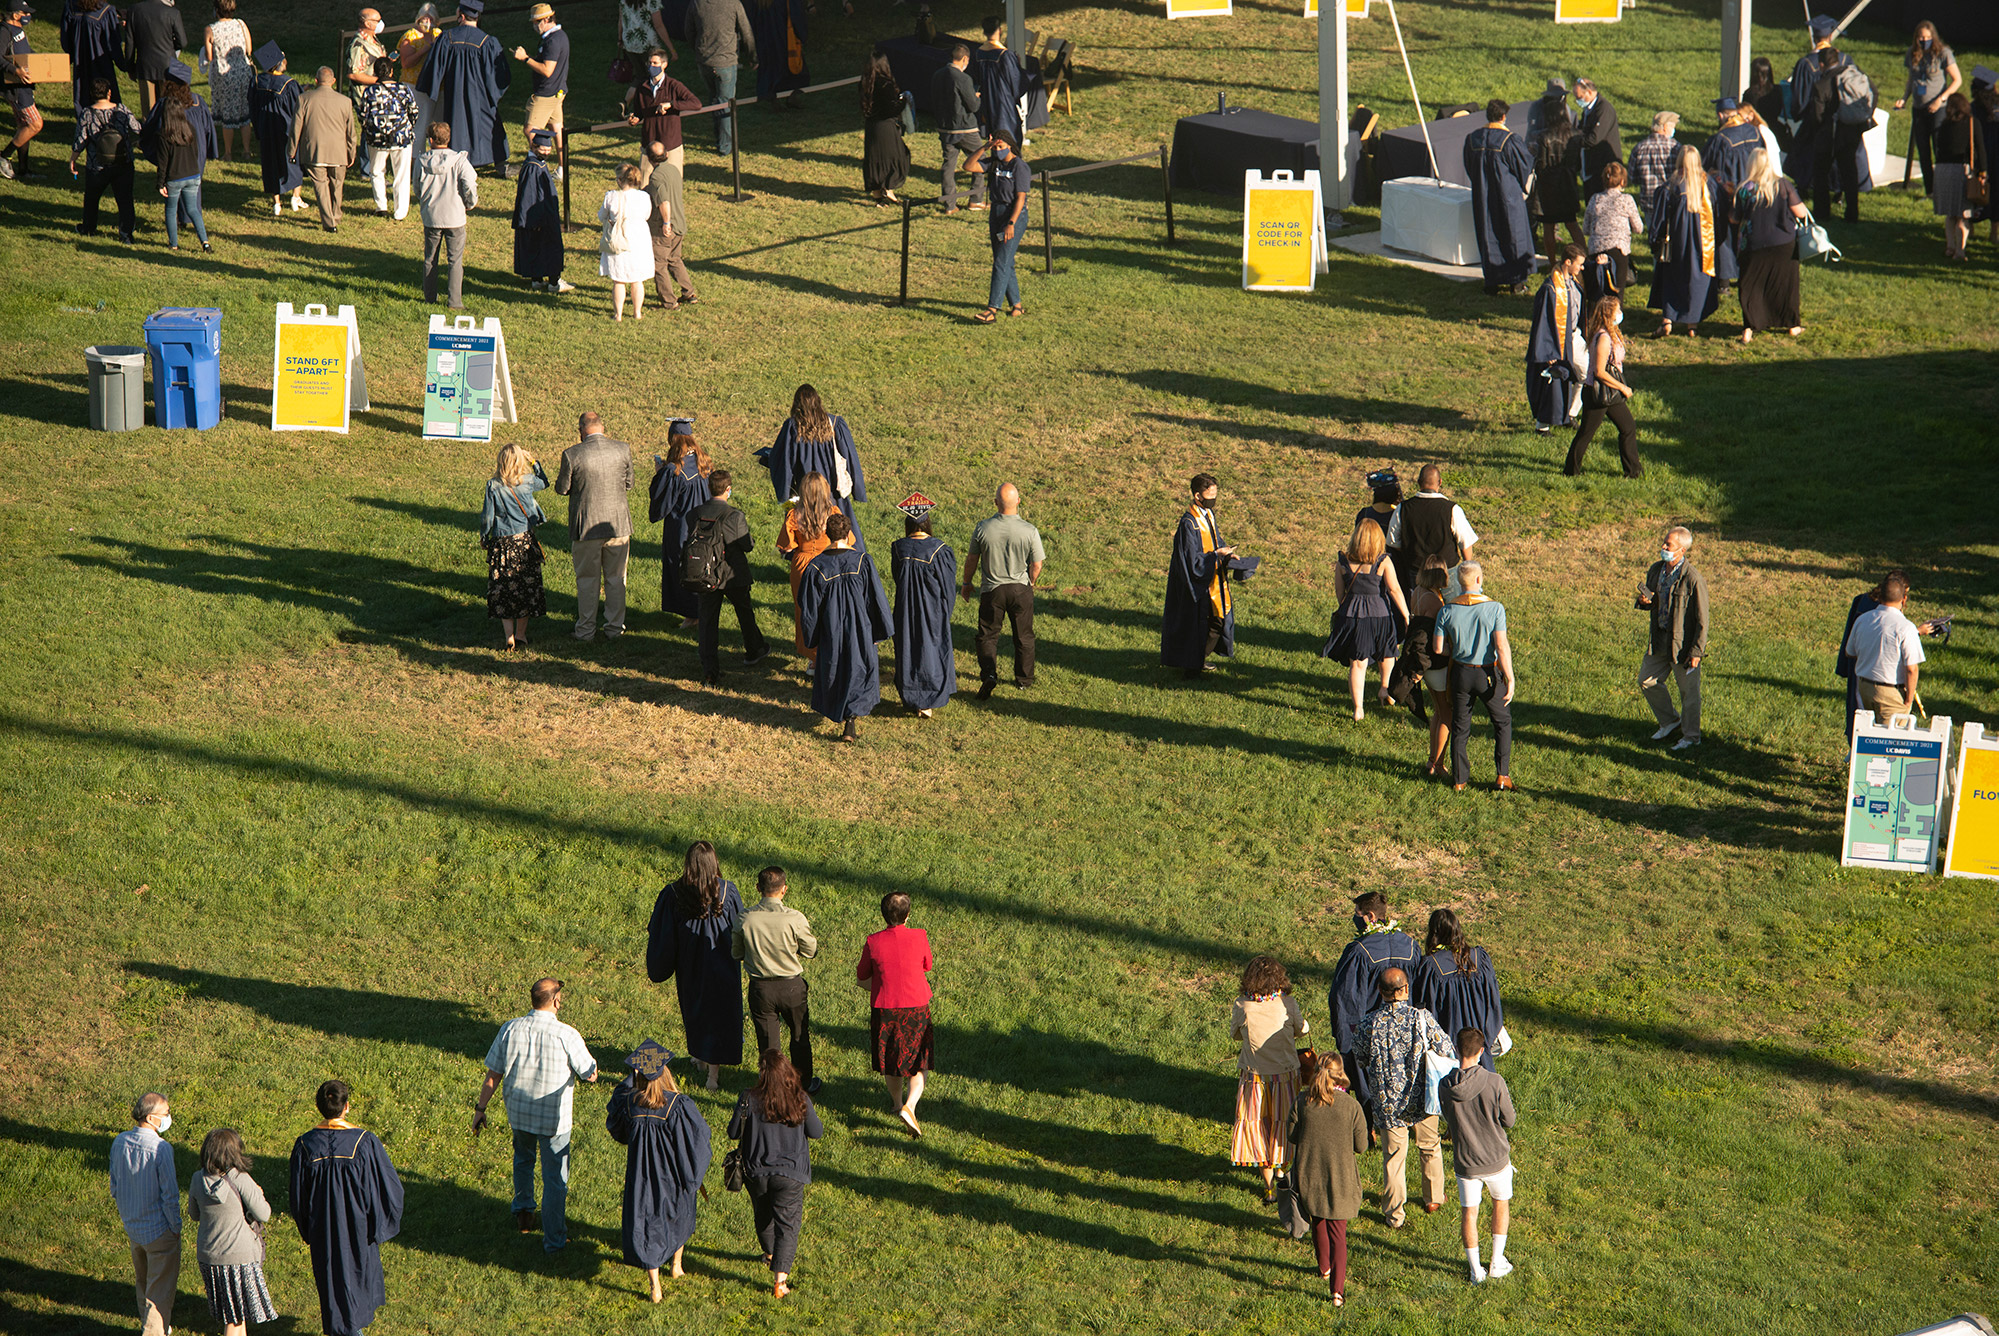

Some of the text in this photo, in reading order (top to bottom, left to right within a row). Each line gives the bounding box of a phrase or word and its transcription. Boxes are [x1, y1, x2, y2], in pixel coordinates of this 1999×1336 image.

[286, 357, 318, 366] STAND
[1865, 738, 1918, 747] COMMENCEMENT
[1974, 789, 1999, 800] FLO
